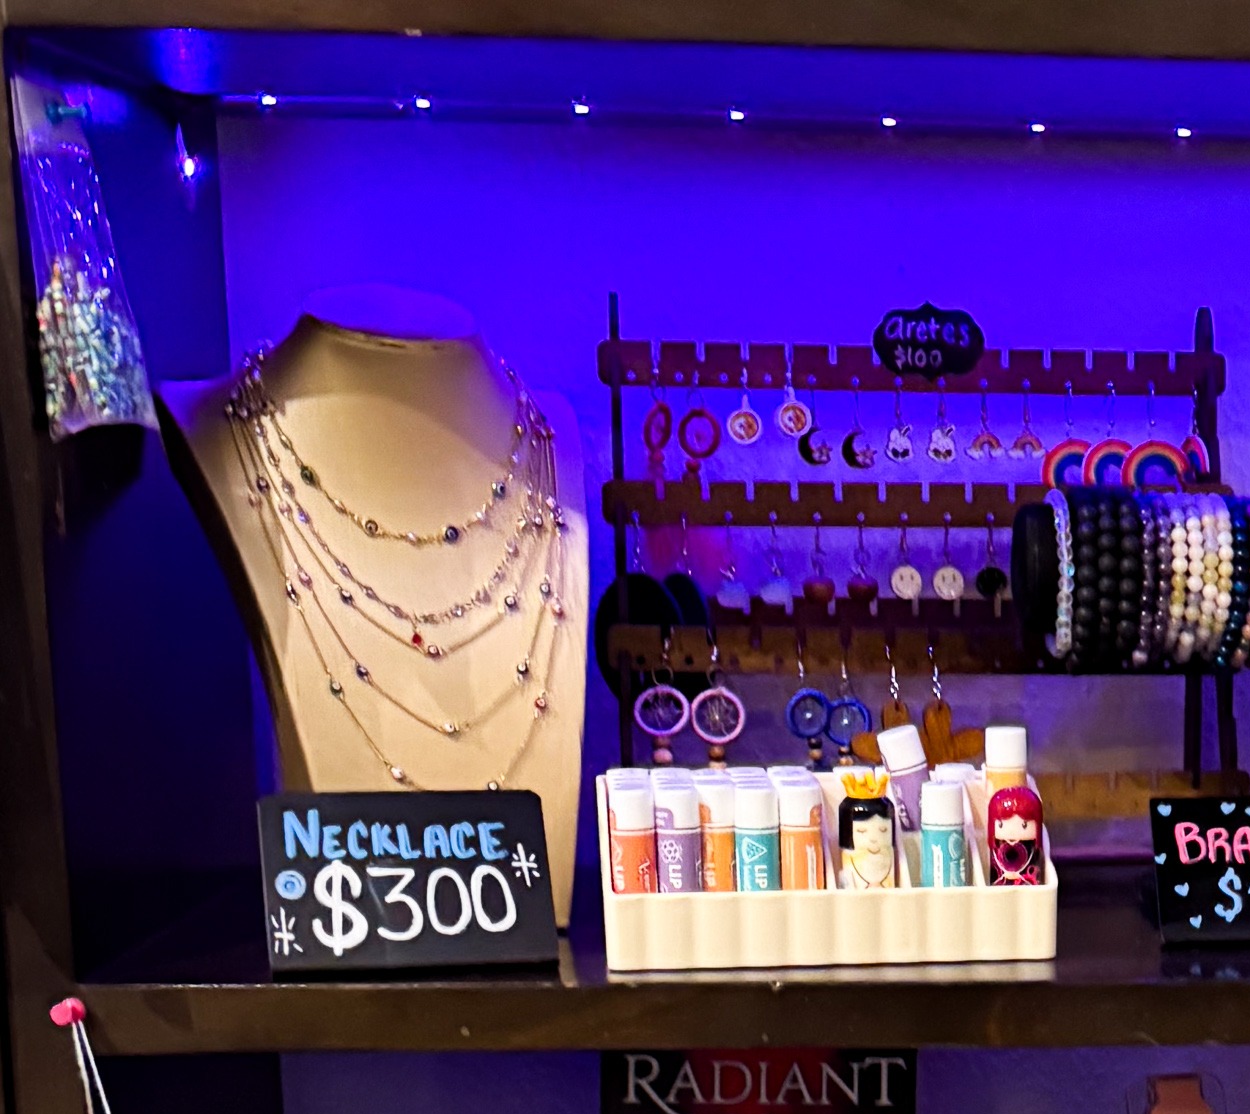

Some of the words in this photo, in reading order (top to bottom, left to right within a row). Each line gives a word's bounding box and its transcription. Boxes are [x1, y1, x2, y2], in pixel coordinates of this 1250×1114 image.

[894, 344, 942, 370] $100
[282, 808, 510, 861] NECKLACE
[668, 864, 683, 889] LIP
[754, 864, 768, 889] LIP
[312, 859, 517, 957] $300
